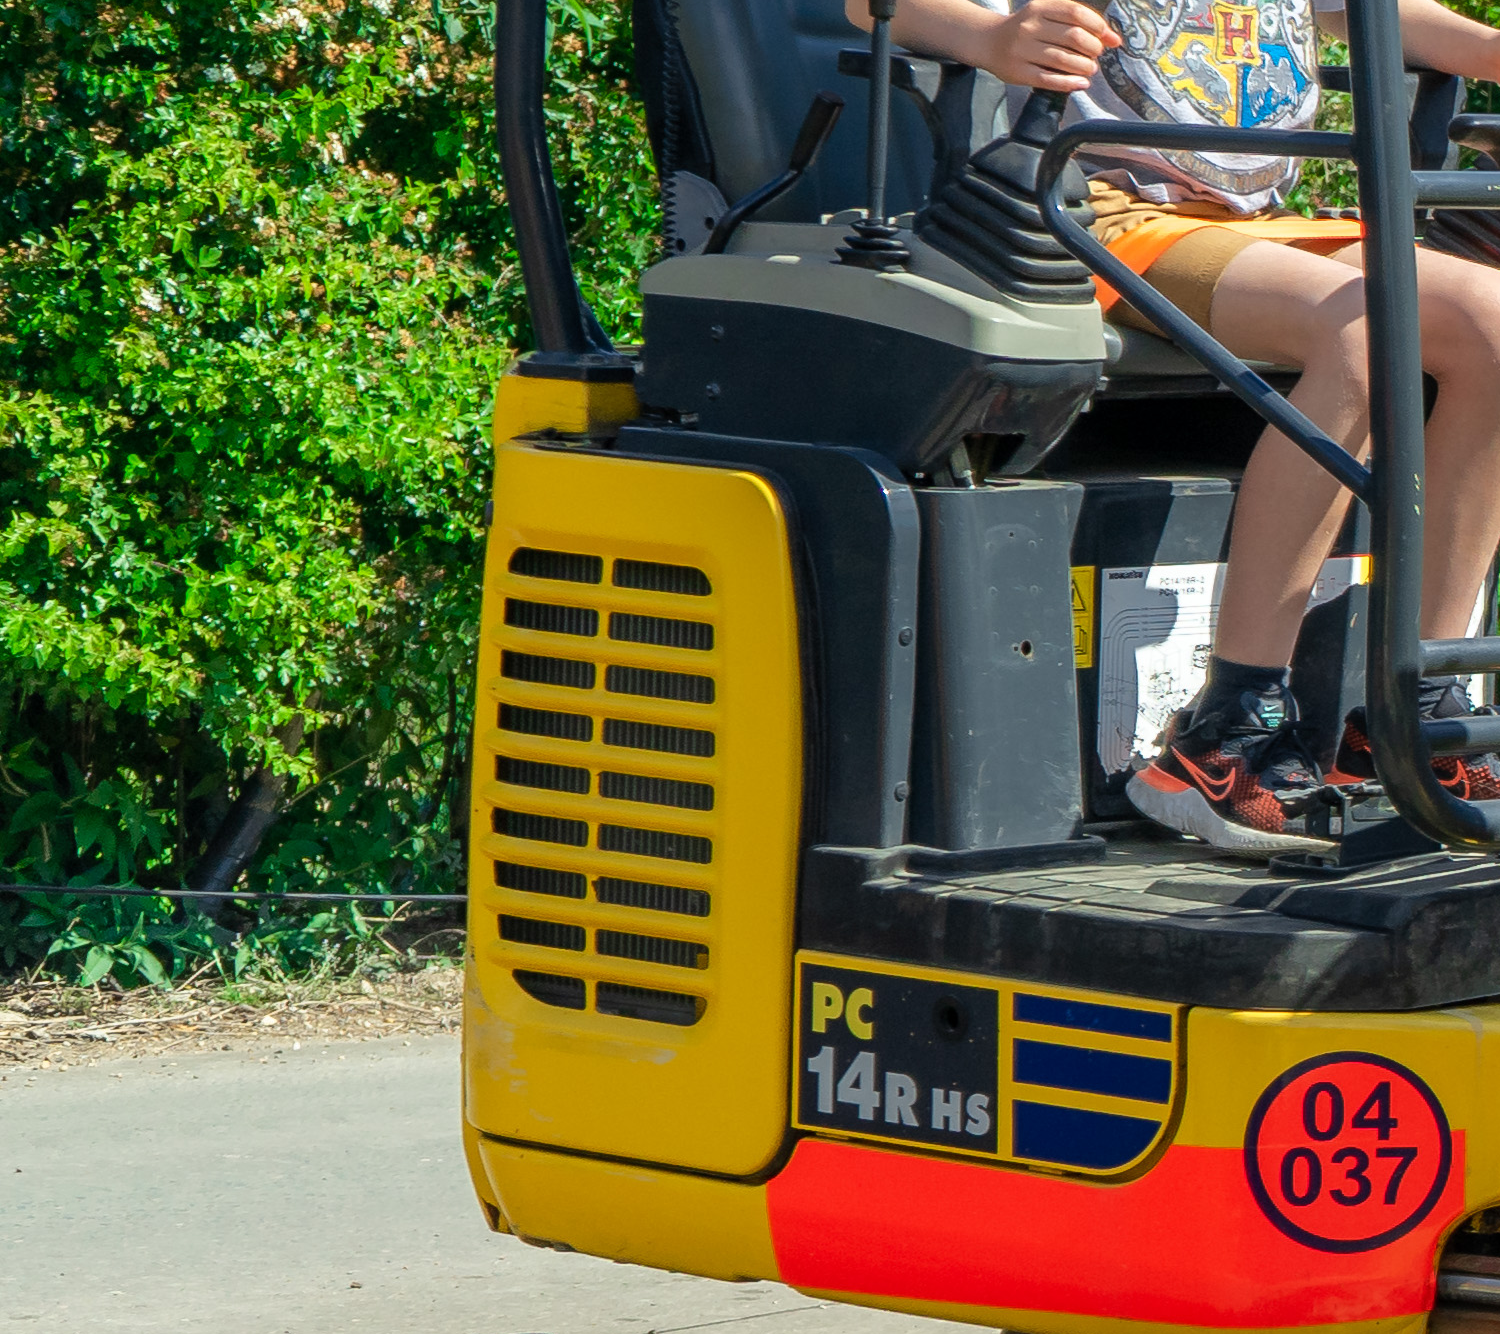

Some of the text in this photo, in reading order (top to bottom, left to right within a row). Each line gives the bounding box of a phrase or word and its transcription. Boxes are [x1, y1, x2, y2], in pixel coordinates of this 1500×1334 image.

[811, 981, 873, 1040] PC
[807, 1045, 991, 1136] 14R HS
[1302, 1081, 1398, 1141] 04
[1280, 1146, 1418, 1207] 037
